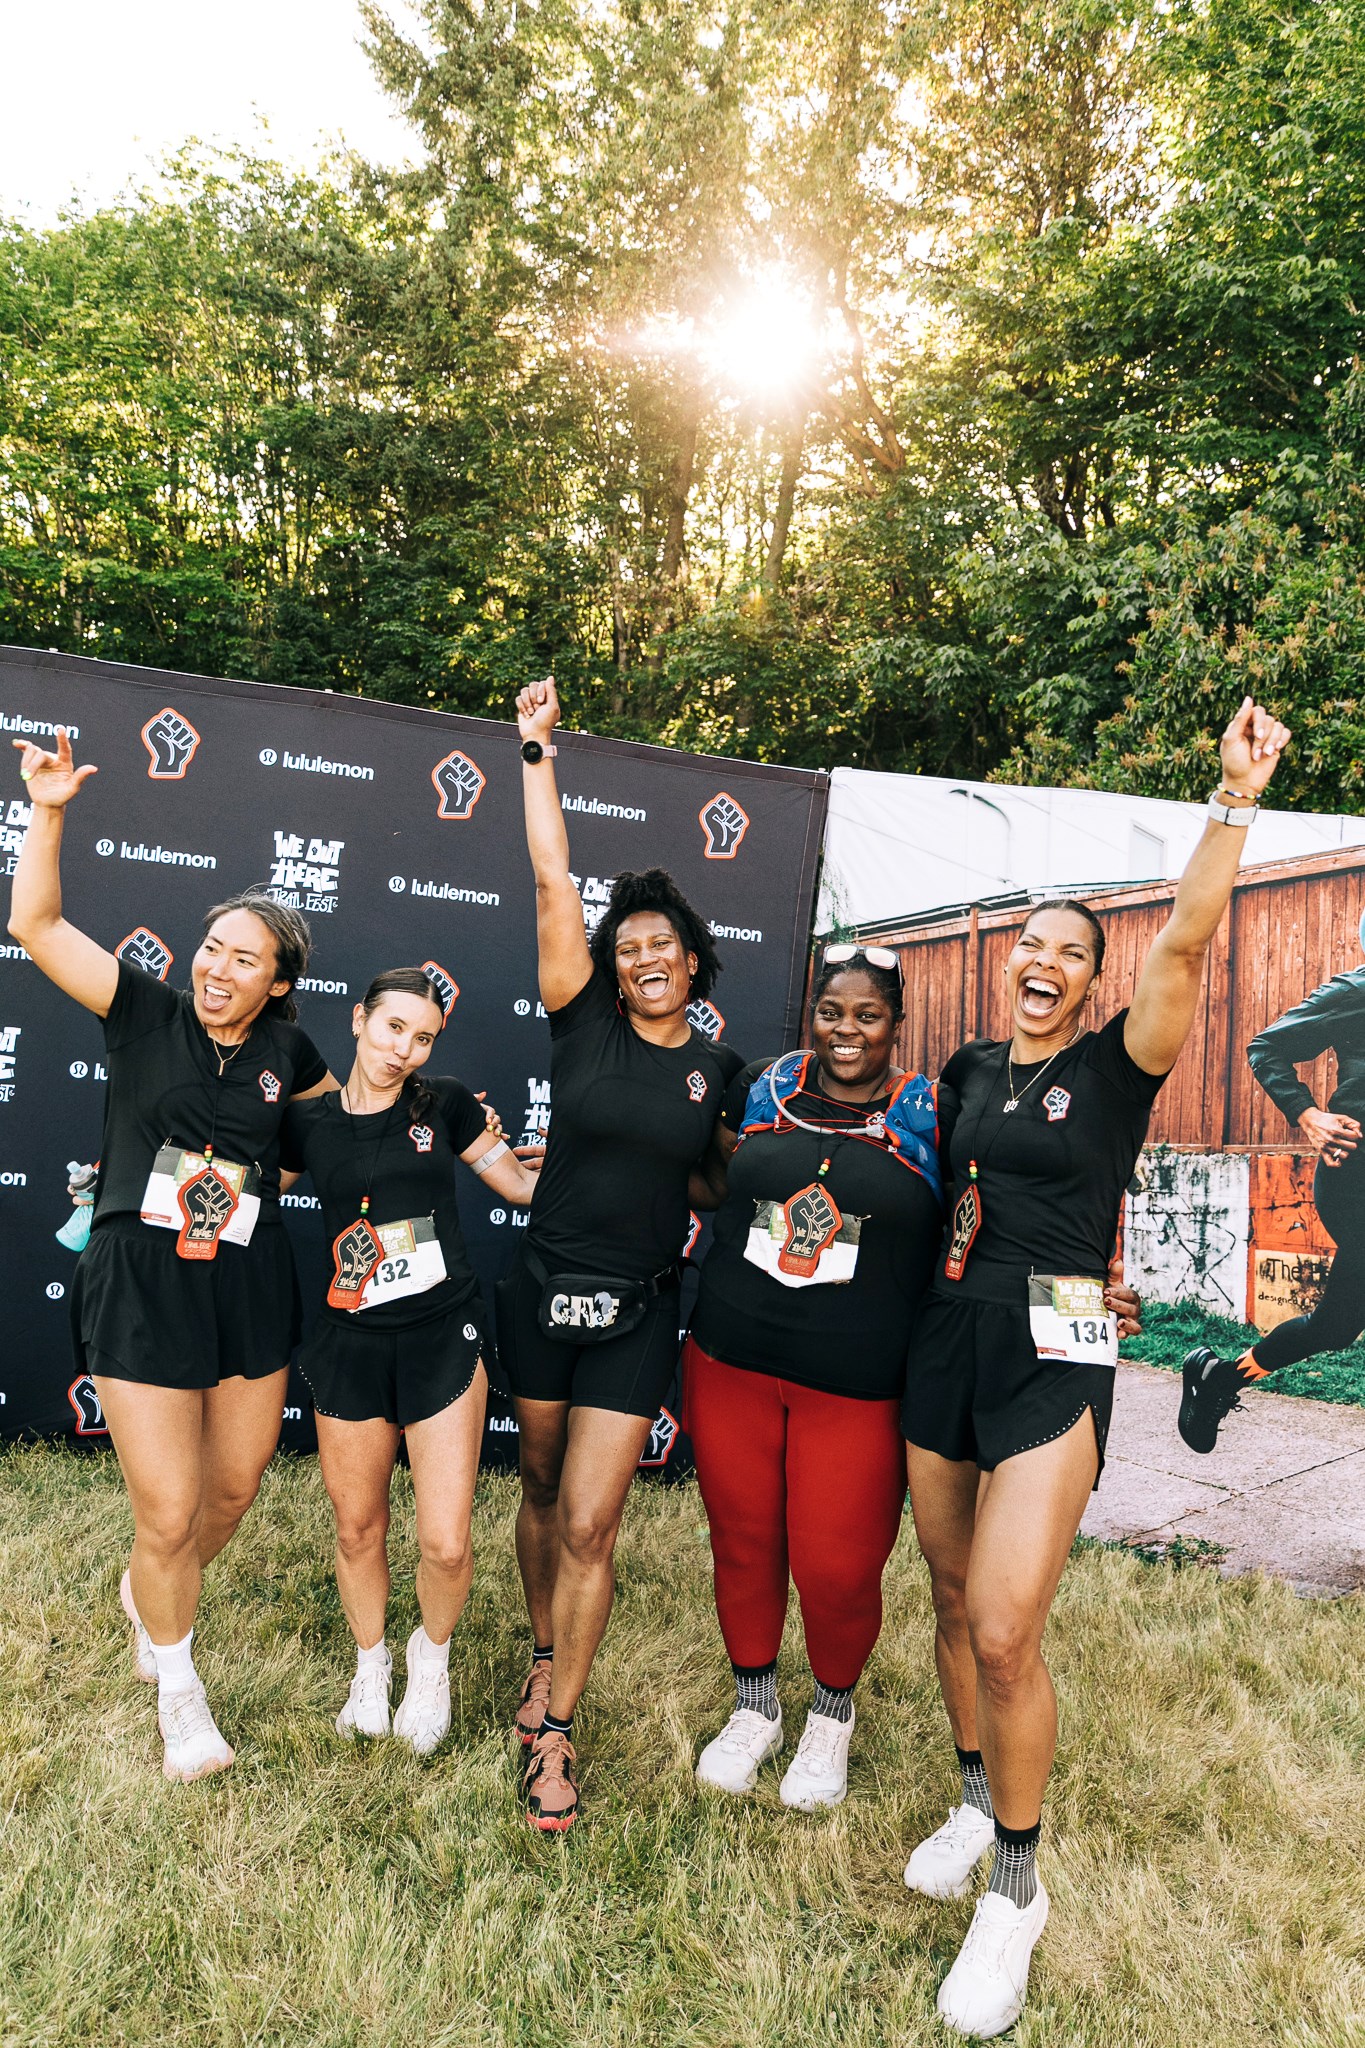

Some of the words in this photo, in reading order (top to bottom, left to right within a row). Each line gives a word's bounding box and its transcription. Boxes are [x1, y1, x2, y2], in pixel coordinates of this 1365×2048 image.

[0, 713, 79, 739] lulemon
[283, 752, 374, 780] lululemon
[5, 800, 34, 827] OU
[561, 793, 646, 822] lululemon
[120, 841, 217, 869] lululemon
[273, 830, 305, 858] WE
[305, 838, 345, 866] OUT
[269, 858, 340, 893] HERE
[410, 878, 500, 906] lululemon
[707, 920, 762, 942] lemon
[372, 1258, 411, 1287] 132
[1266, 1258, 1300, 1282] The
[1069, 1320, 1108, 1345] 134
